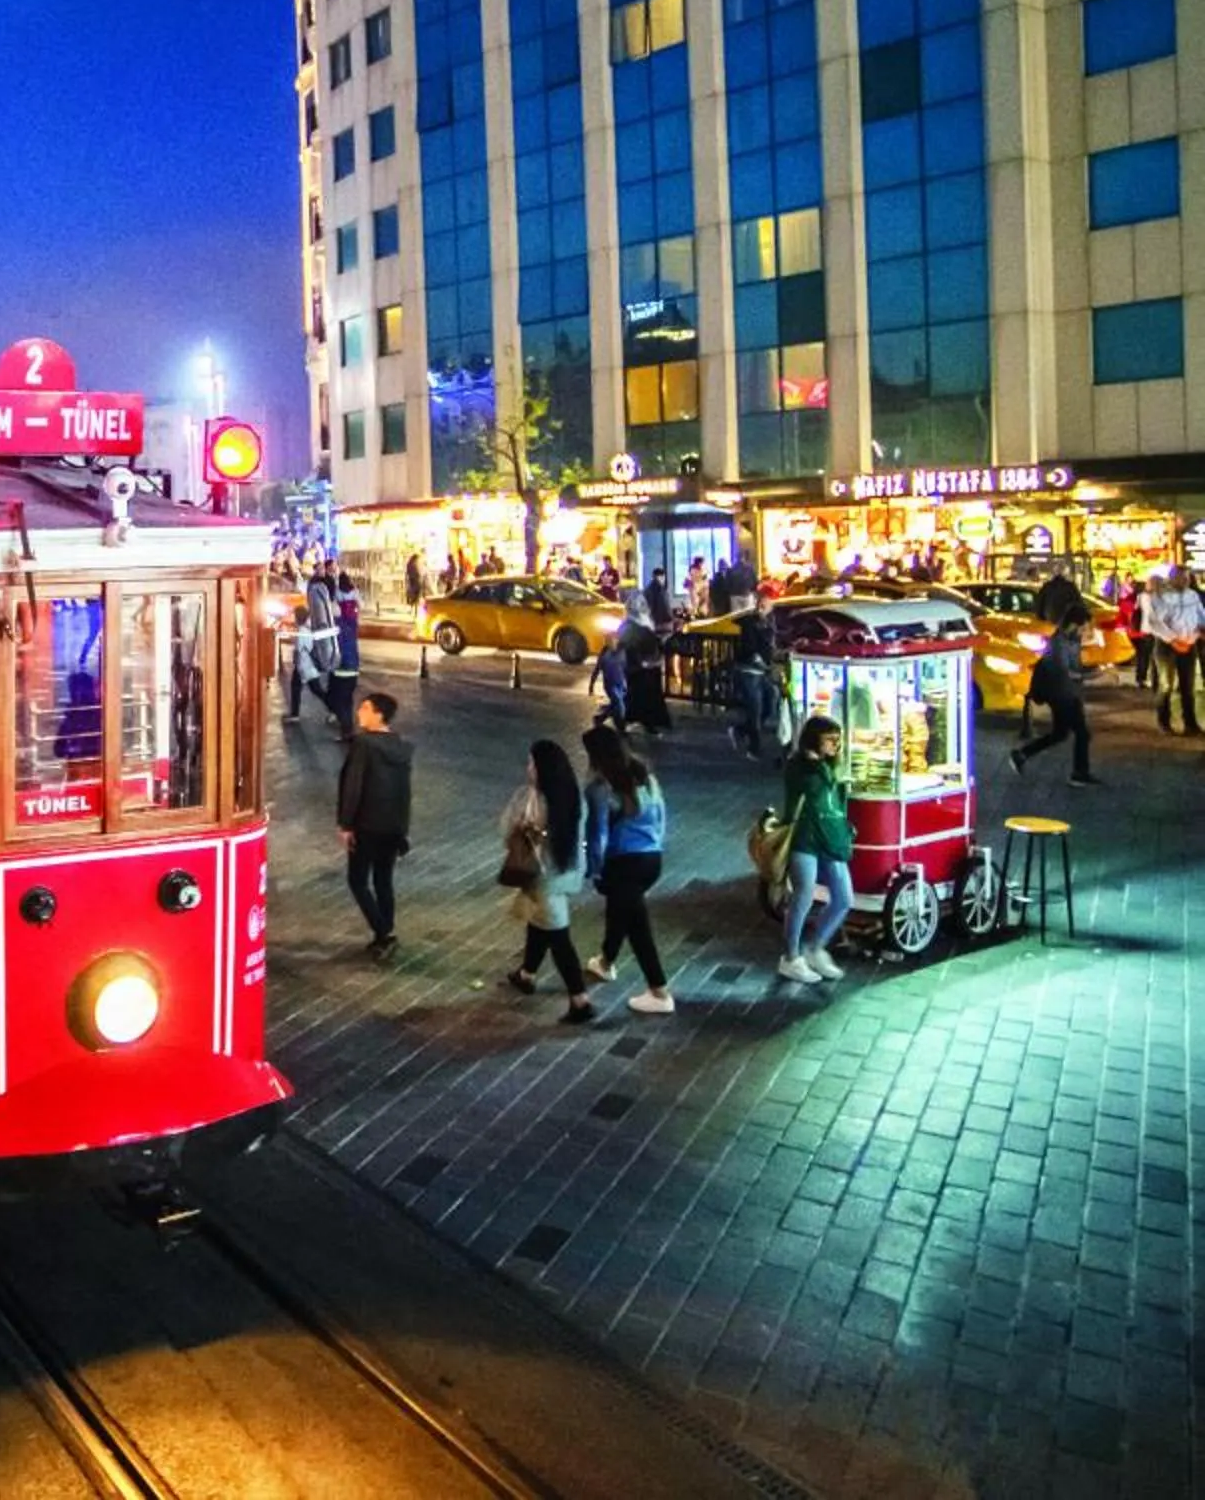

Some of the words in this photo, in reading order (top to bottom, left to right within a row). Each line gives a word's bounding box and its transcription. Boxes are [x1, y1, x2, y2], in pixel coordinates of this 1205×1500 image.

[25, 345, 44, 385] 2
[60, 400, 131, 440] TÜNEL
[912, 469, 992, 496] MUSTAFA
[24, 794, 91, 816] TÜNEL
